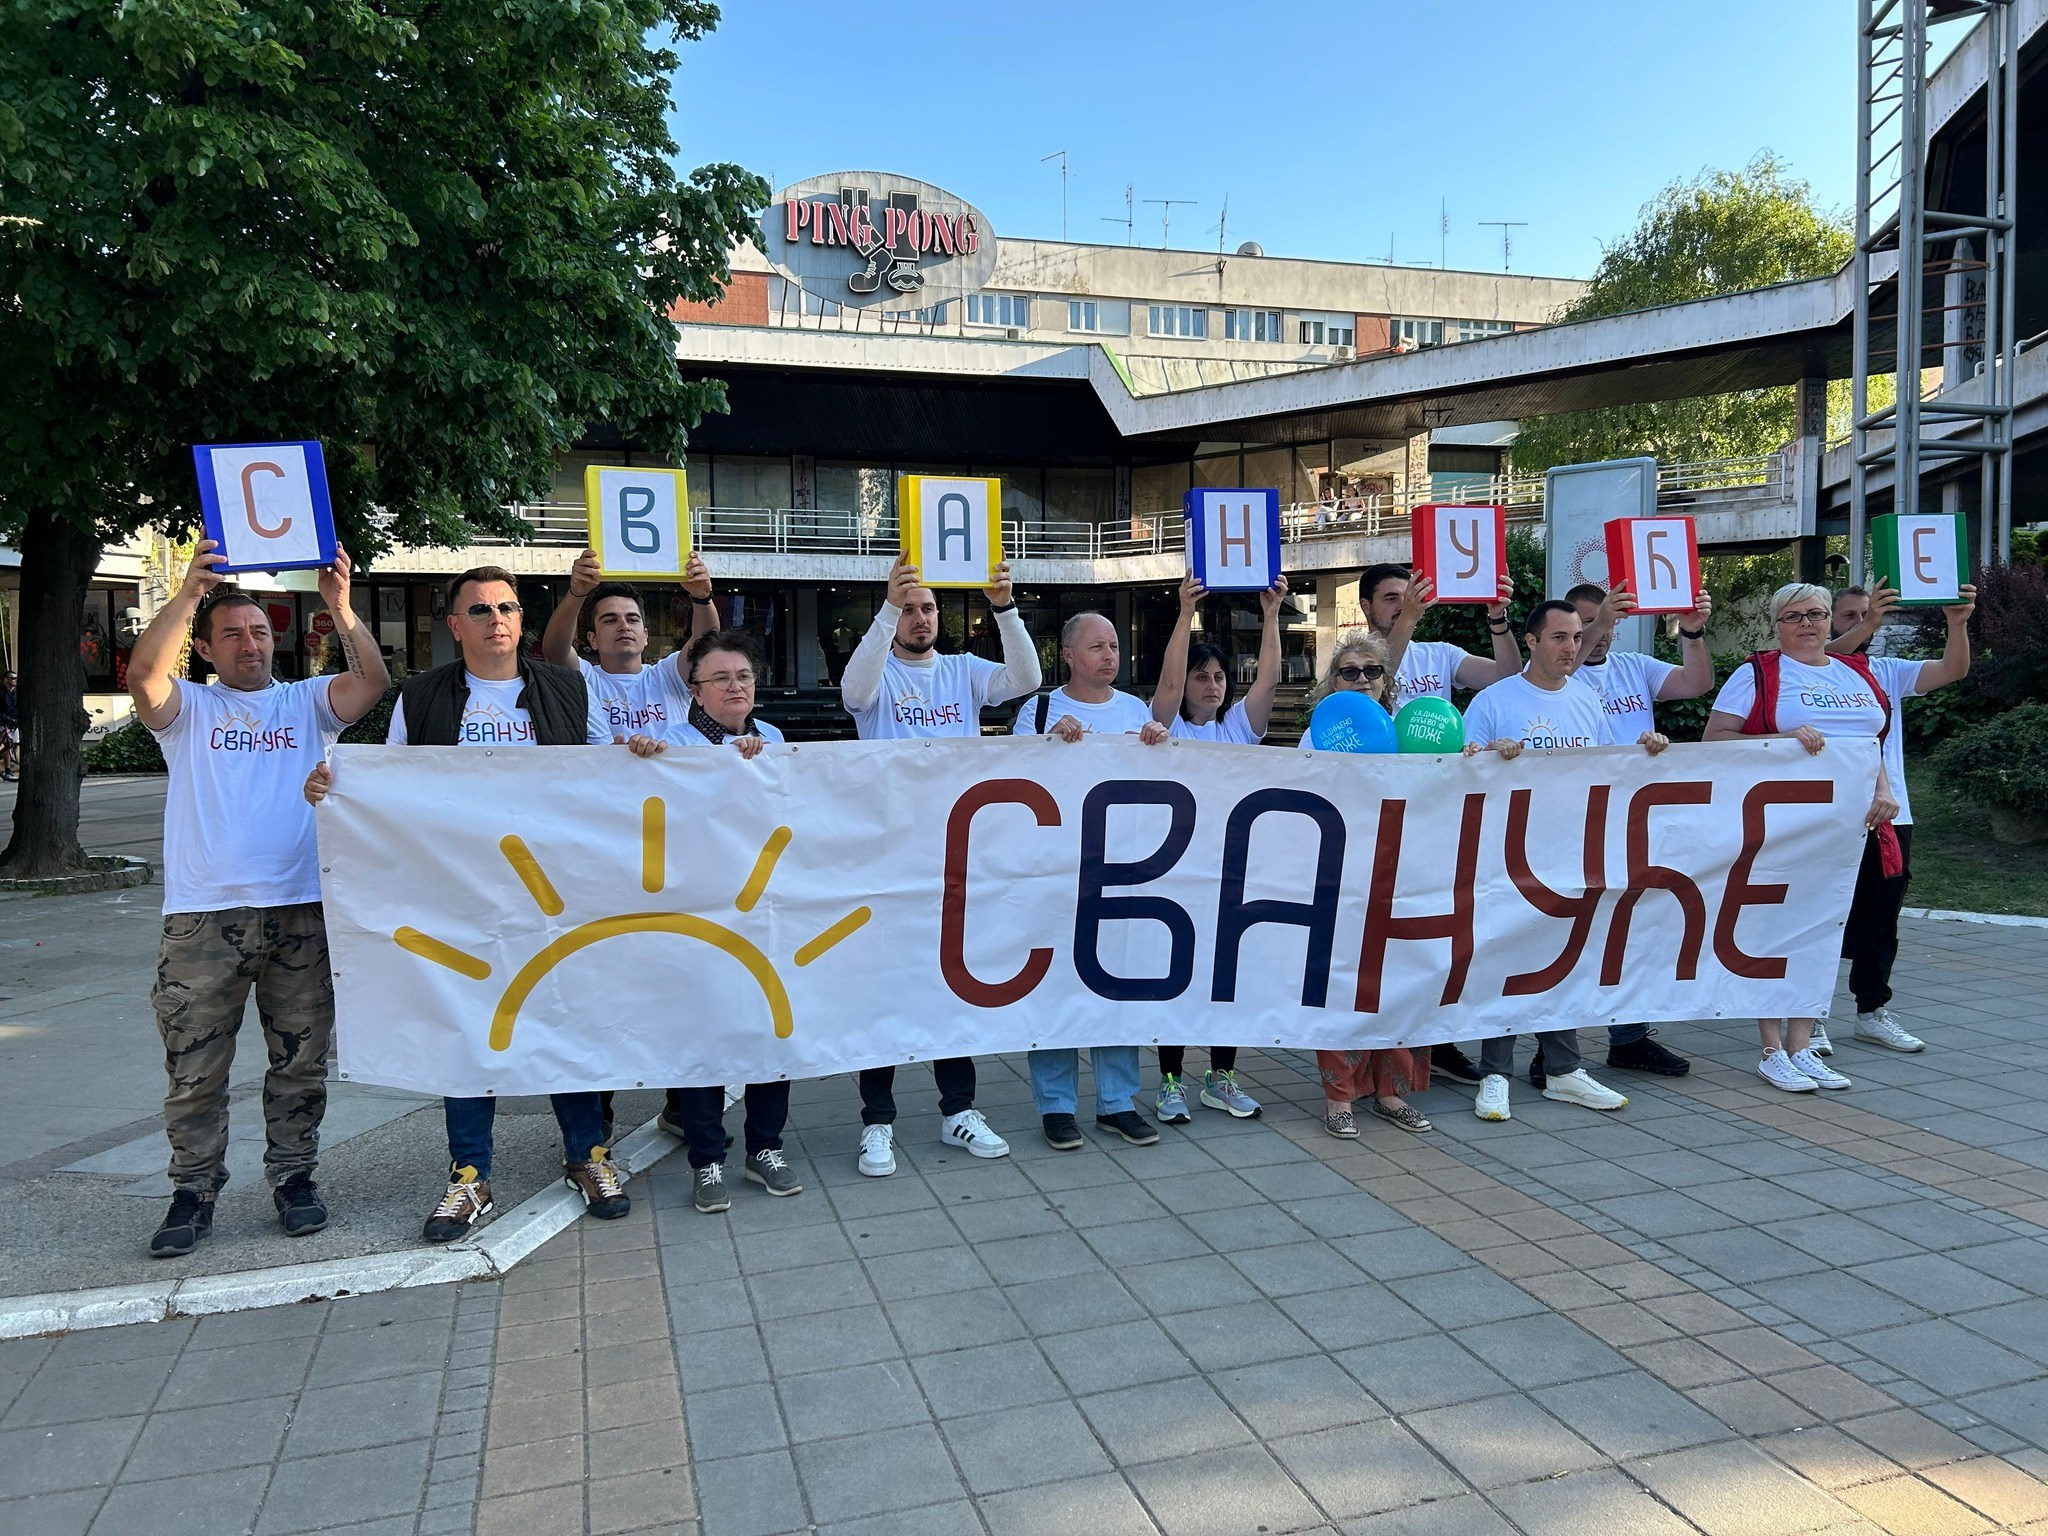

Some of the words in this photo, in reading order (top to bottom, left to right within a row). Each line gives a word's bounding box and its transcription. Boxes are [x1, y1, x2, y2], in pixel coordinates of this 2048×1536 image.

[786, 198, 873, 246] PING
[884, 207, 979, 256] PONG
[240, 461, 292, 539] С
[618, 486, 660, 554] В
[937, 493, 972, 562] А
[1219, 504, 1253, 568] Н
[1449, 519, 1479, 579] У
[1912, 527, 1938, 584] Е
[314, 619, 333, 627] 360
[210, 727, 298, 753] СВАНУЋЕ
[602, 703, 667, 729] ВАНУЋЕ
[1406, 723, 1445, 745] МОЖЕ
[940, 778, 1835, 1014] СВАНУЋЕ
